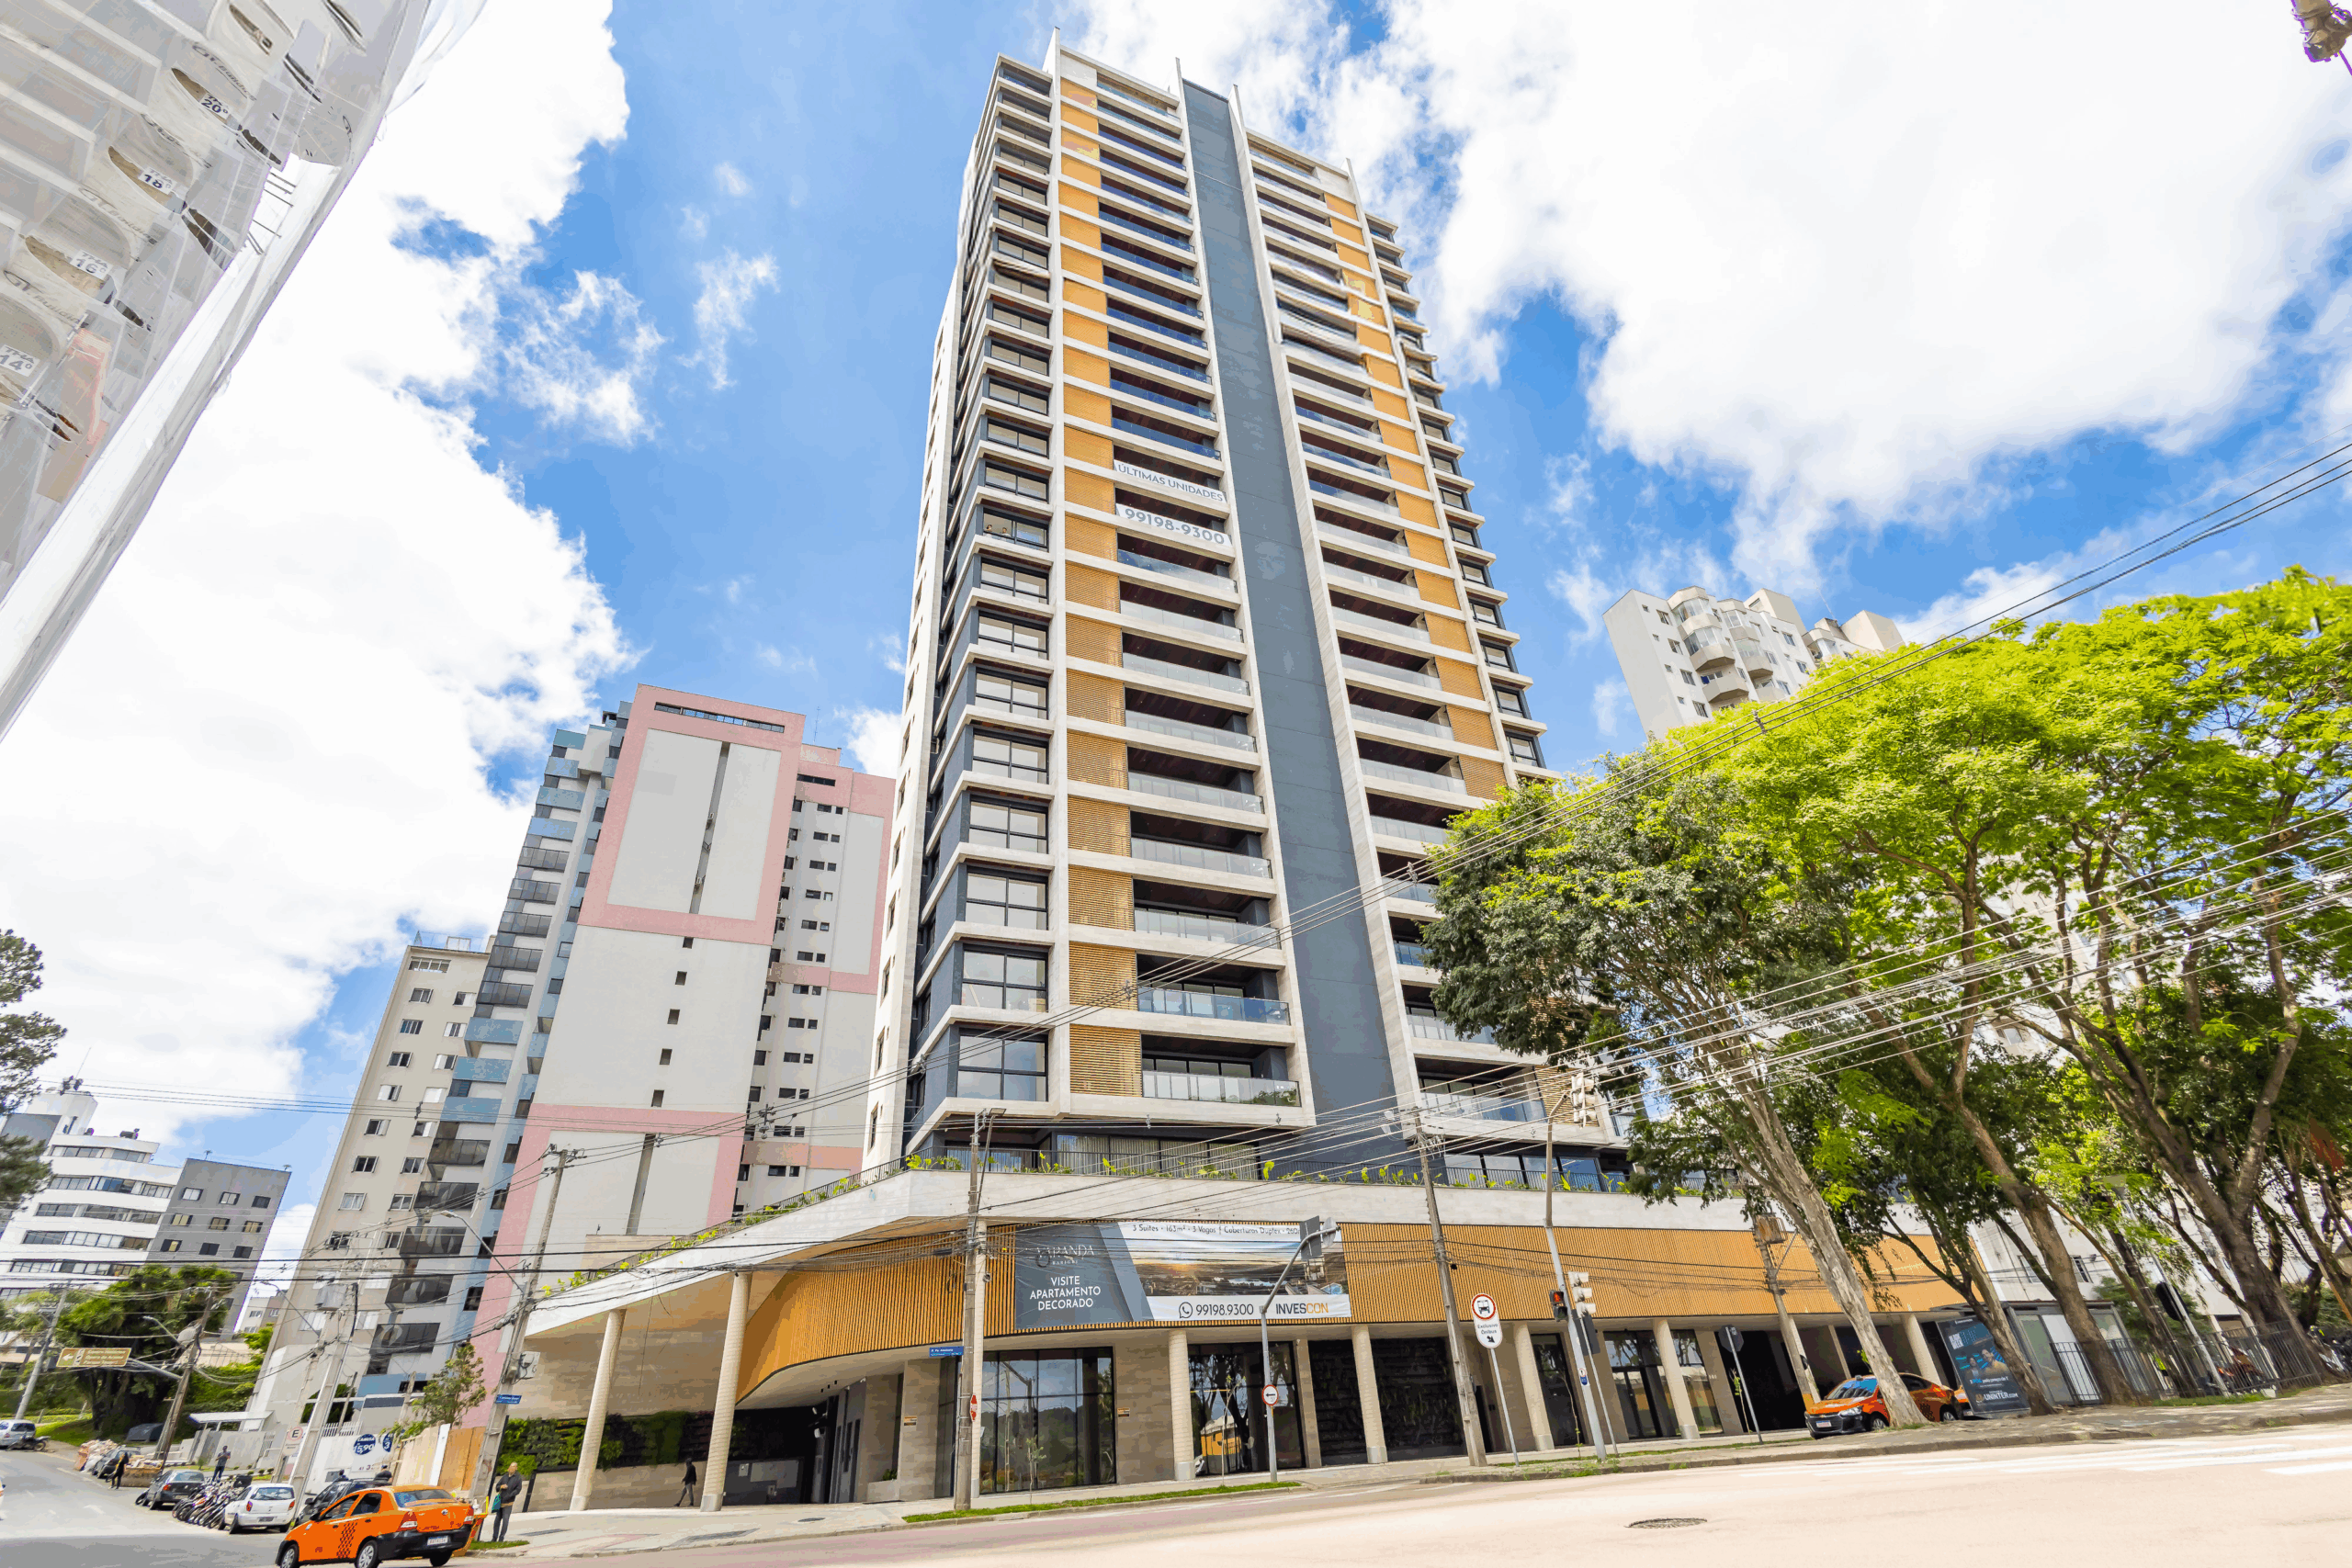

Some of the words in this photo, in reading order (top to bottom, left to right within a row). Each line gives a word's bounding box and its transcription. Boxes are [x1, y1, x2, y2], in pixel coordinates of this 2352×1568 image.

[1118, 464, 1166, 486] ÚLTIMAS
[1168, 479, 1224, 502] UNIDADES
[1125, 508, 1225, 545] 99198-9300
[1224, 1226, 1258, 1235] Coberturas
[1050, 1275, 1080, 1286] VISITE
[1029, 1286, 1101, 1300] APARTAMENTO
[1038, 1298, 1093, 1311] DECORADO
[1195, 1303, 1254, 1316] 99198.9300
[1275, 1303, 1329, 1314] INVESCON
[291, 1429, 300, 1438] E
